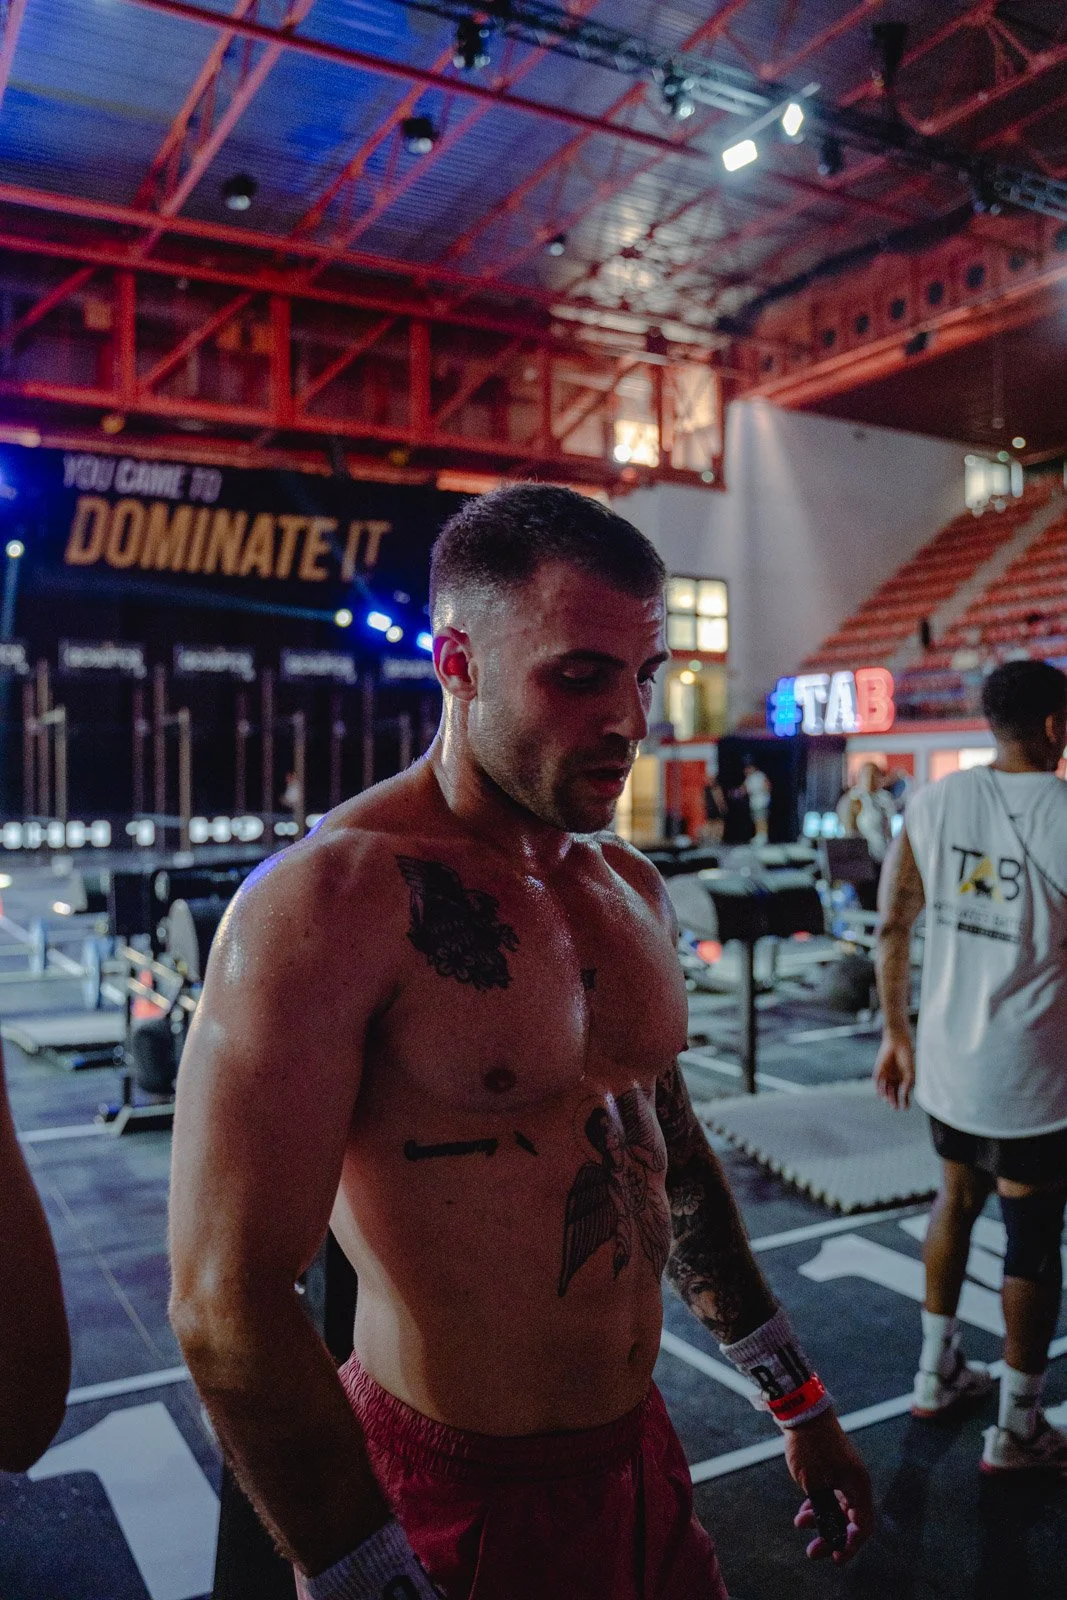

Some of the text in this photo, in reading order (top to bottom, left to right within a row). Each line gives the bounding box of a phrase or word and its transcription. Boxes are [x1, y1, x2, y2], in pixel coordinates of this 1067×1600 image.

[63, 453, 223, 503] YOU CAME TO
[64, 496, 392, 582] DOMINATE IT
